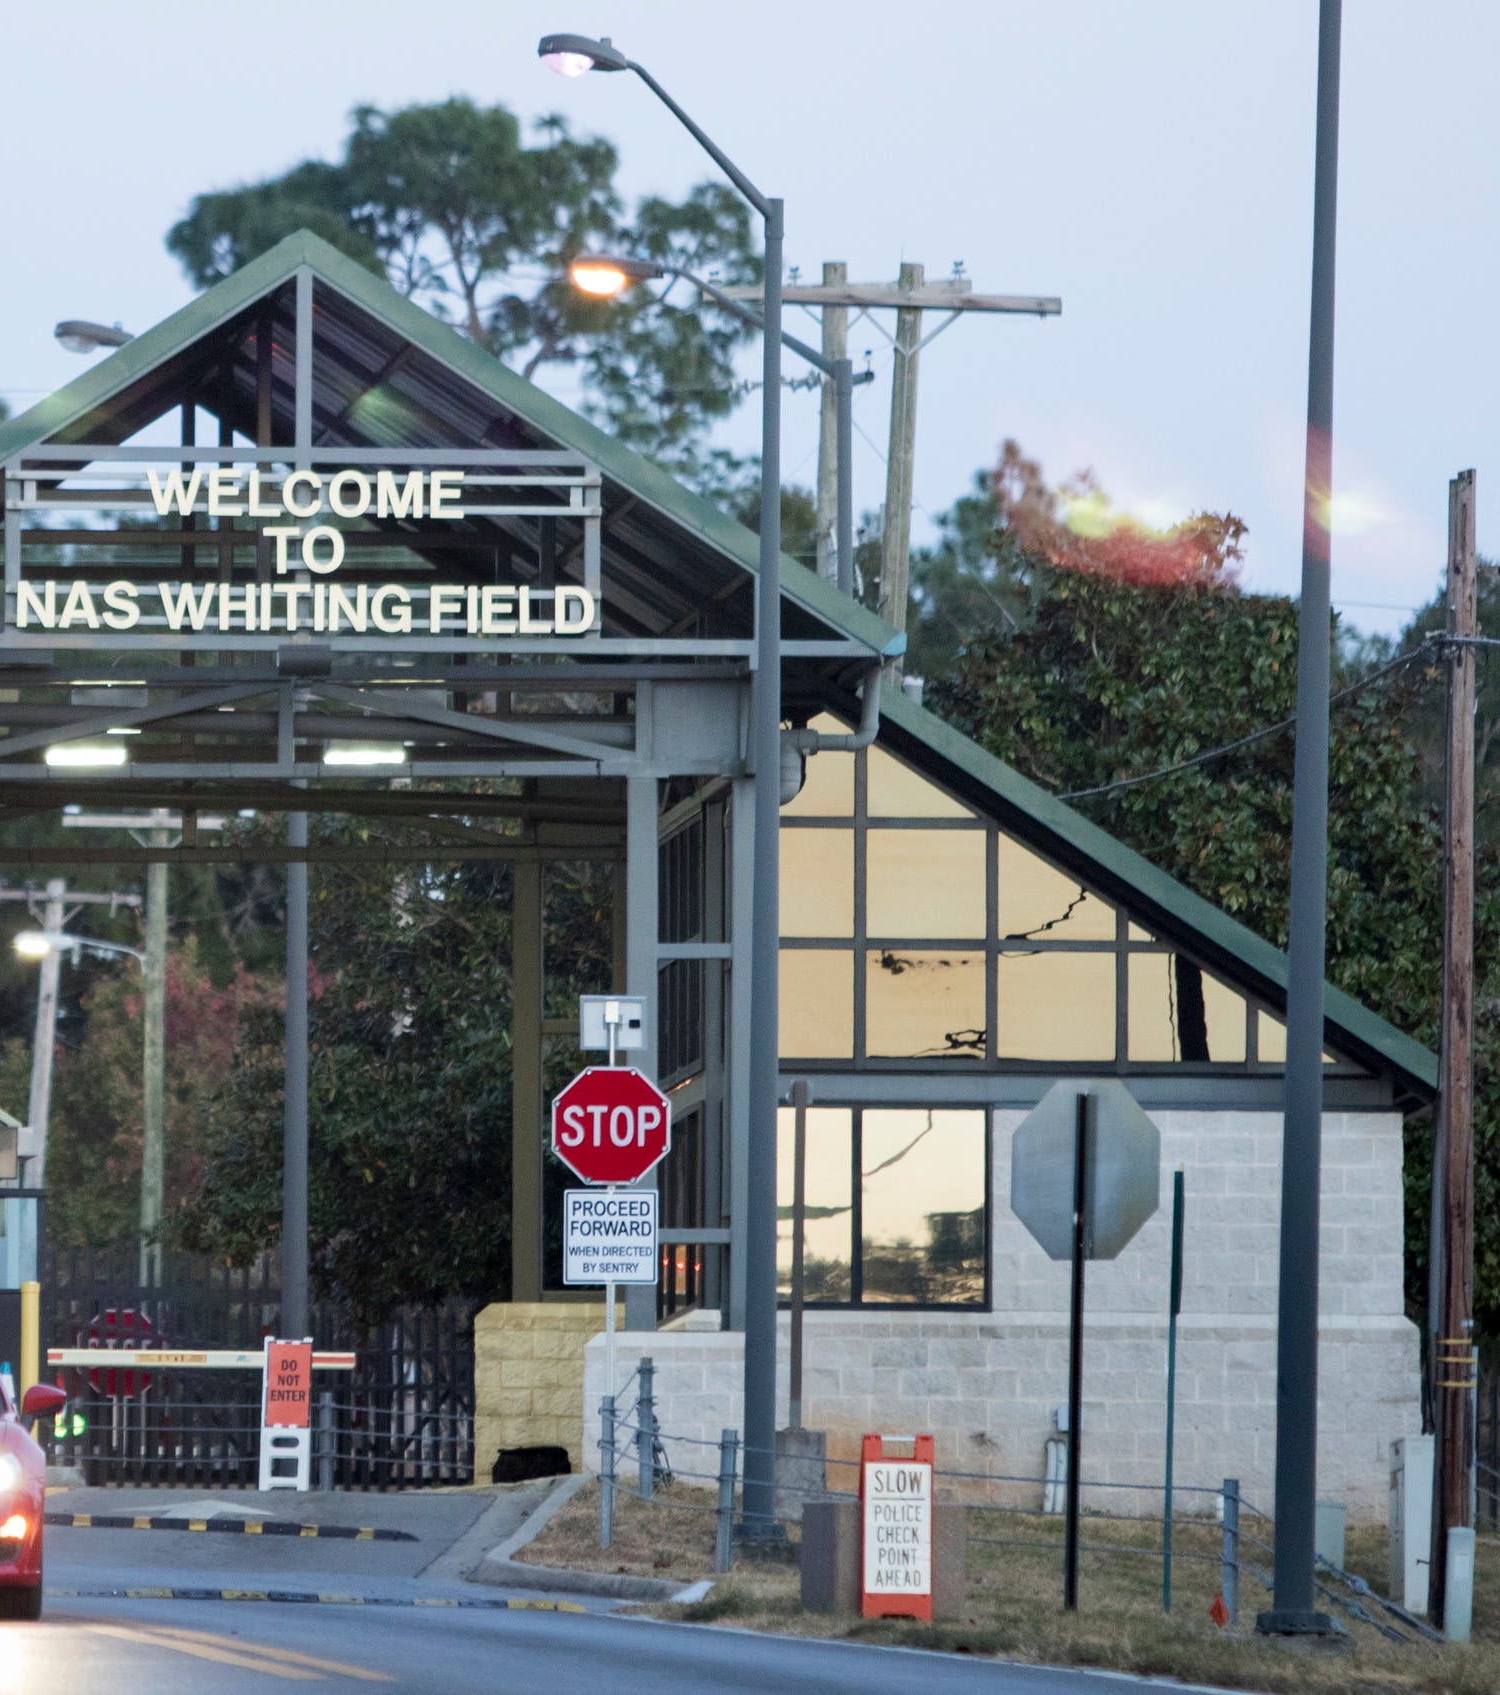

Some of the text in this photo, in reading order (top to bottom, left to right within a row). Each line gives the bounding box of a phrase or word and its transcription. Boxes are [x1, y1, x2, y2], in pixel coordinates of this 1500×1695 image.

[147, 469, 465, 519] WELCOME
[263, 526, 345, 575] TO
[16, 581, 595, 635] NAS WHITING FIELD
[561, 1105, 661, 1147] STOP
[572, 1200, 650, 1217] PROCEED
[570, 1220, 652, 1237] FORWARD
[569, 1246, 653, 1257] WHEN DIRECTED
[582, 1262, 639, 1273] BY SENTRY
[281, 1360, 297, 1371] DO
[278, 1375, 300, 1386] NOT
[271, 1390, 306, 1402] ENTER
[874, 1470, 922, 1493] SLOW
[874, 1505, 922, 1522] POLICE
[876, 1526, 919, 1544] CHECK
[878, 1548, 917, 1566] POINT
[875, 1570, 922, 1587] AHEAD
